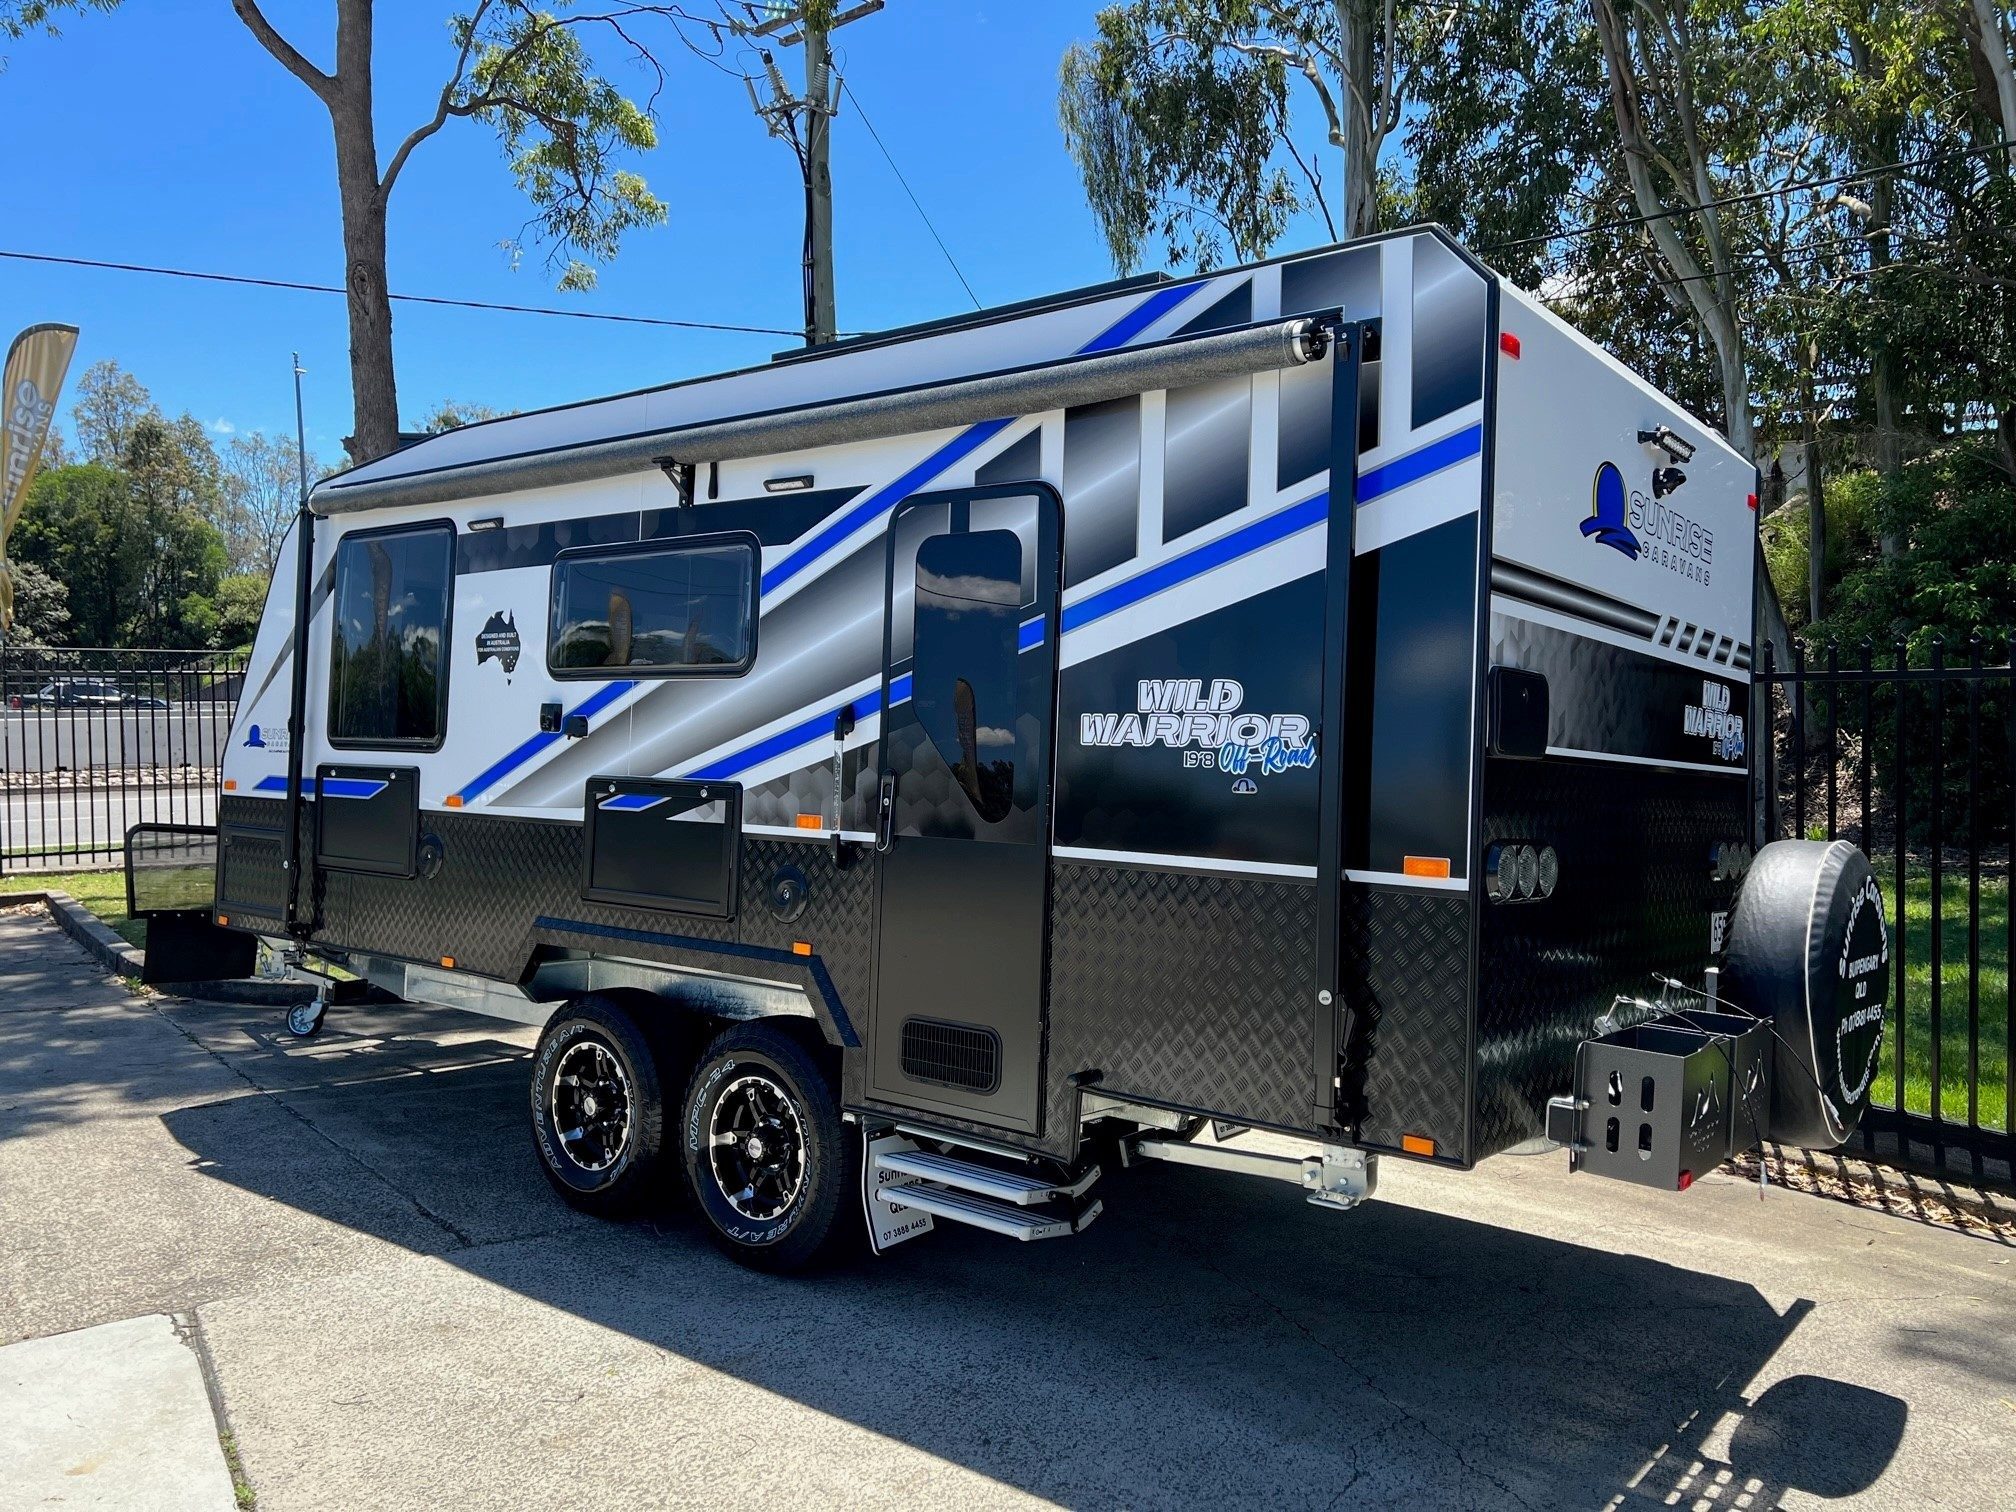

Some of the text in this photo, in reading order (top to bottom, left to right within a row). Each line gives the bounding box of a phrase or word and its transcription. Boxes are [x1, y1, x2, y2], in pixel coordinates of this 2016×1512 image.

[1629, 490, 1714, 565] SUNRISE
[1642, 541, 1711, 587] CARAVANS
[1137, 678, 1243, 713] WILD
[1702, 680, 1730, 713] WILD
[261, 728, 289, 740] SUNR
[1080, 713, 1310, 748] WARRIOR
[1684, 705, 1744, 740] WARRIOR
[1218, 735, 1317, 775] Off-Road
[1838, 875, 1888, 979] Sunrise Caravans
[1855, 981, 1867, 999] QLD
[534, 1024, 586, 1169] ADVENTURE A/T
[883, 1218, 927, 1241] 07 3888 4455
